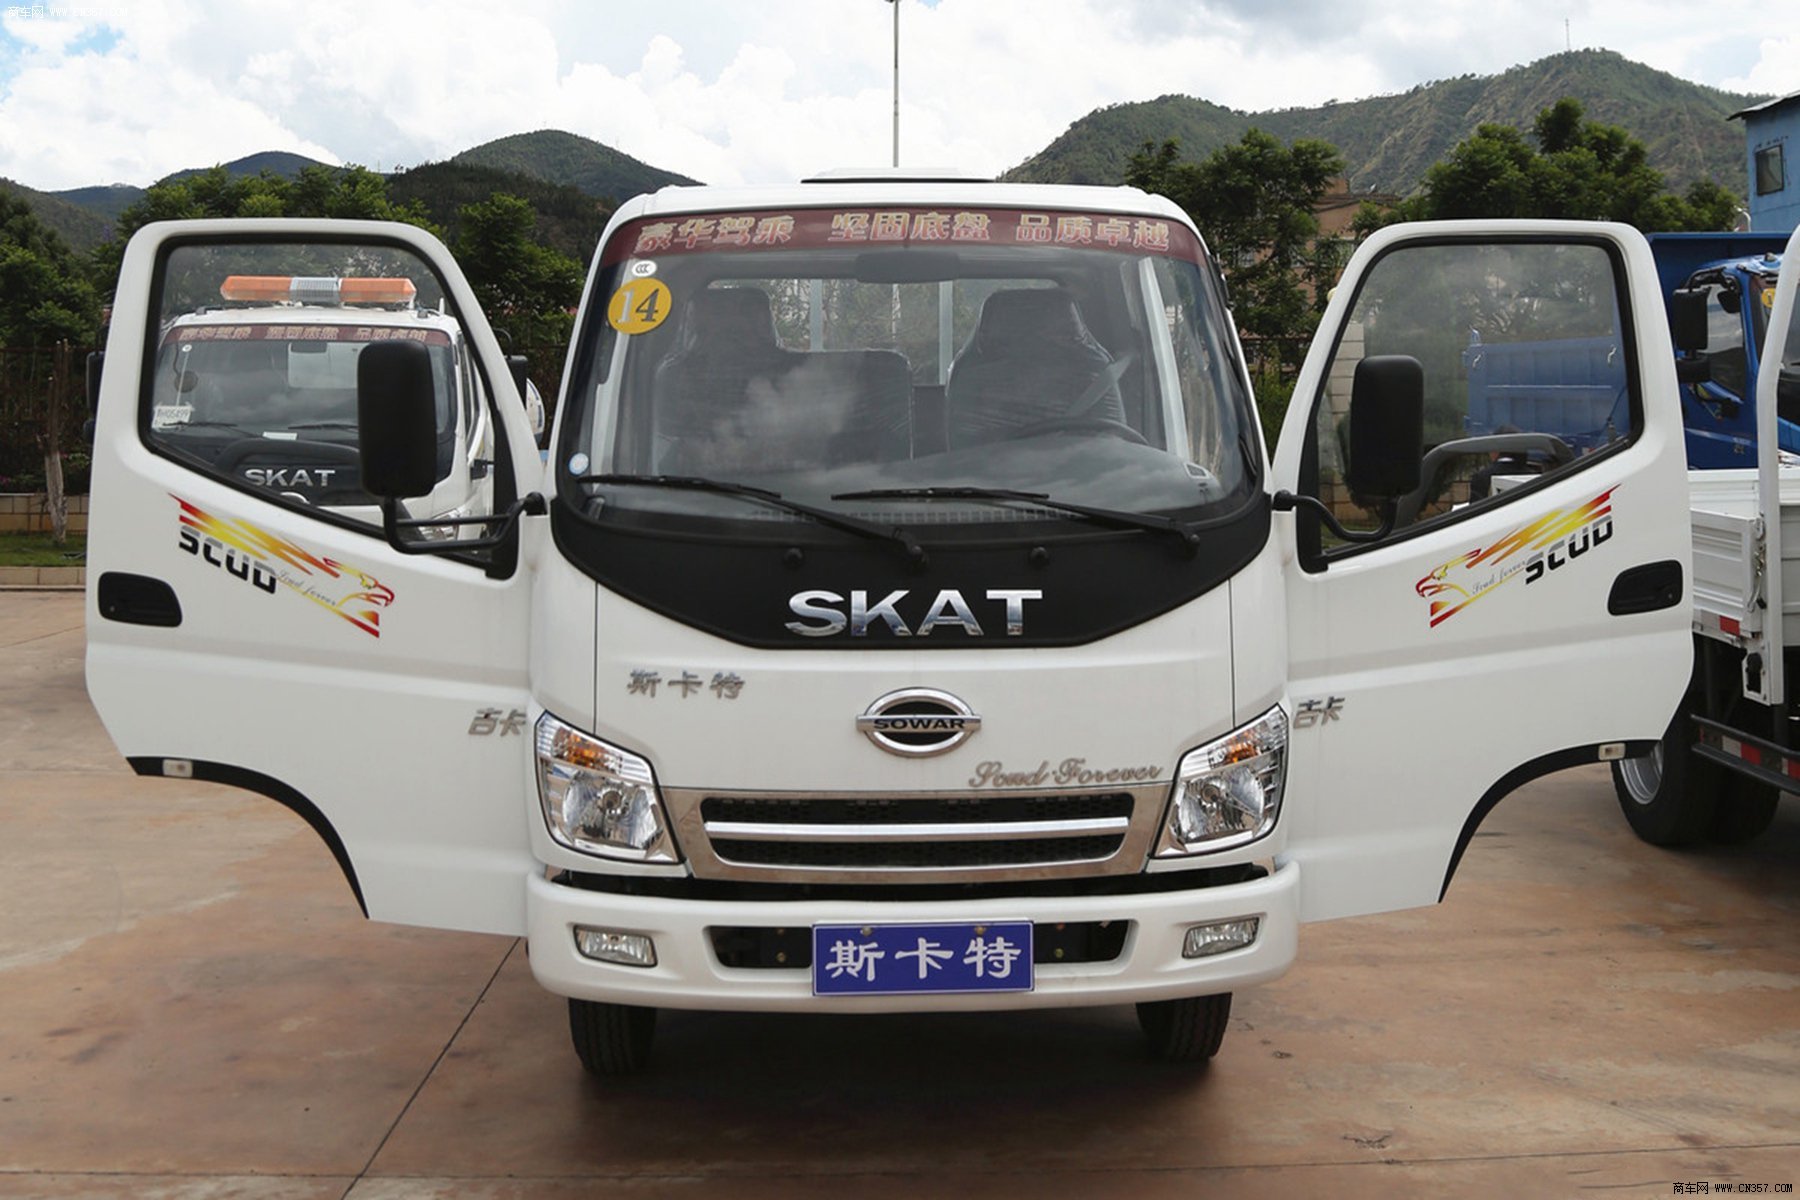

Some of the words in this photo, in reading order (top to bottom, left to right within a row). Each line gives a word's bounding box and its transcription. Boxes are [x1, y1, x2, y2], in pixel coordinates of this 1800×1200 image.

[632, 215, 795, 253] 豪华驾乘
[828, 212, 991, 241] 坚固底盘
[1015, 214, 1170, 250] 品质卓越
[615, 287, 660, 323] 14
[244, 468, 336, 487] SKAT
[179, 525, 277, 595] SCUD
[1525, 515, 1613, 584] SCUD
[784, 590, 1043, 637] SKAT
[627, 669, 746, 699] 斯卡特
[873, 718, 965, 729] SOWAR
[1052, 758, 1164, 784] Forever
[825, 936, 1022, 982] 斯卡特
